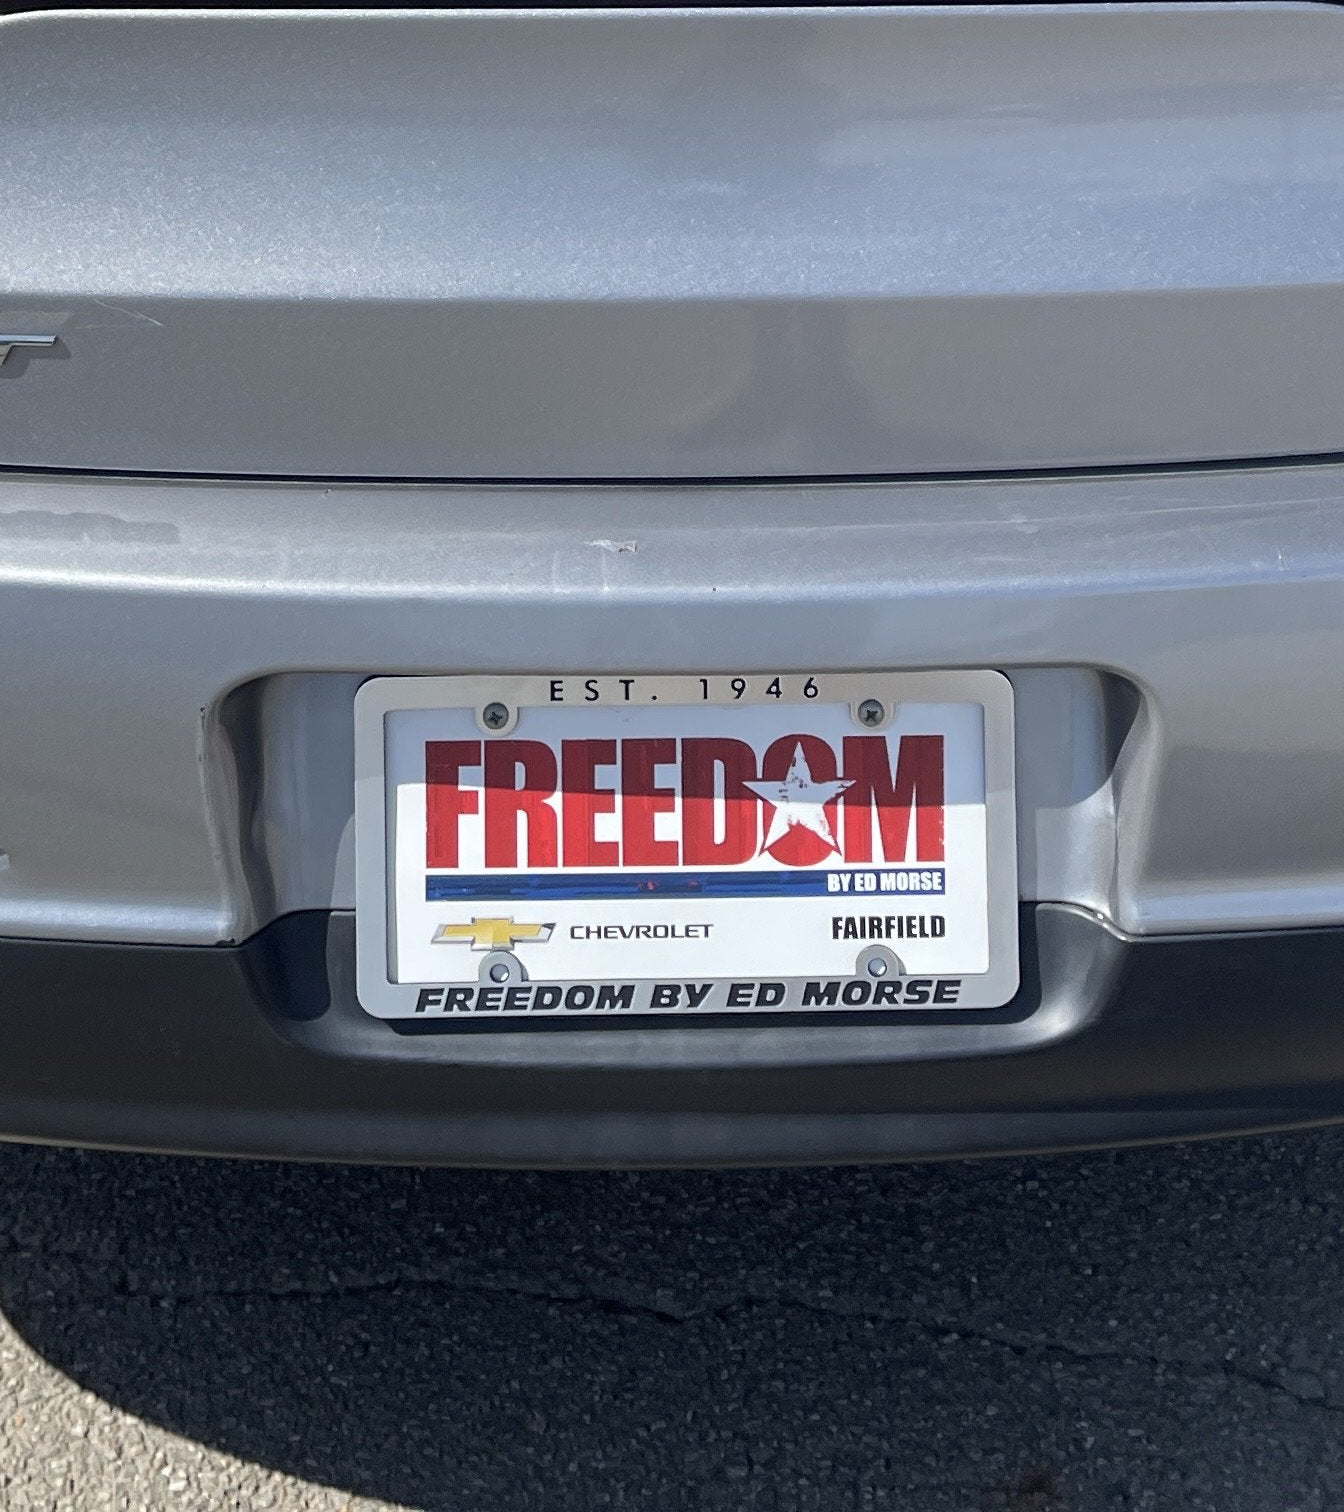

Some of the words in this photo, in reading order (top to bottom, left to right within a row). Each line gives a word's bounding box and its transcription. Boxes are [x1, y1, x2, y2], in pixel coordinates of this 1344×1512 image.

[549, 678, 660, 703] EST.
[699, 676, 821, 701] 1946
[425, 734, 945, 869] FREEDOM
[827, 873, 851, 892] BY
[855, 873, 877, 891] ED
[880, 871, 943, 891] MORSE
[570, 924, 714, 940] CHEVROLET
[831, 915, 946, 940] FAIRFIELD
[415, 985, 635, 1013] FREEDOM
[649, 983, 714, 1010] BY
[726, 982, 787, 1008] ED
[801, 979, 962, 1005] MORSE
